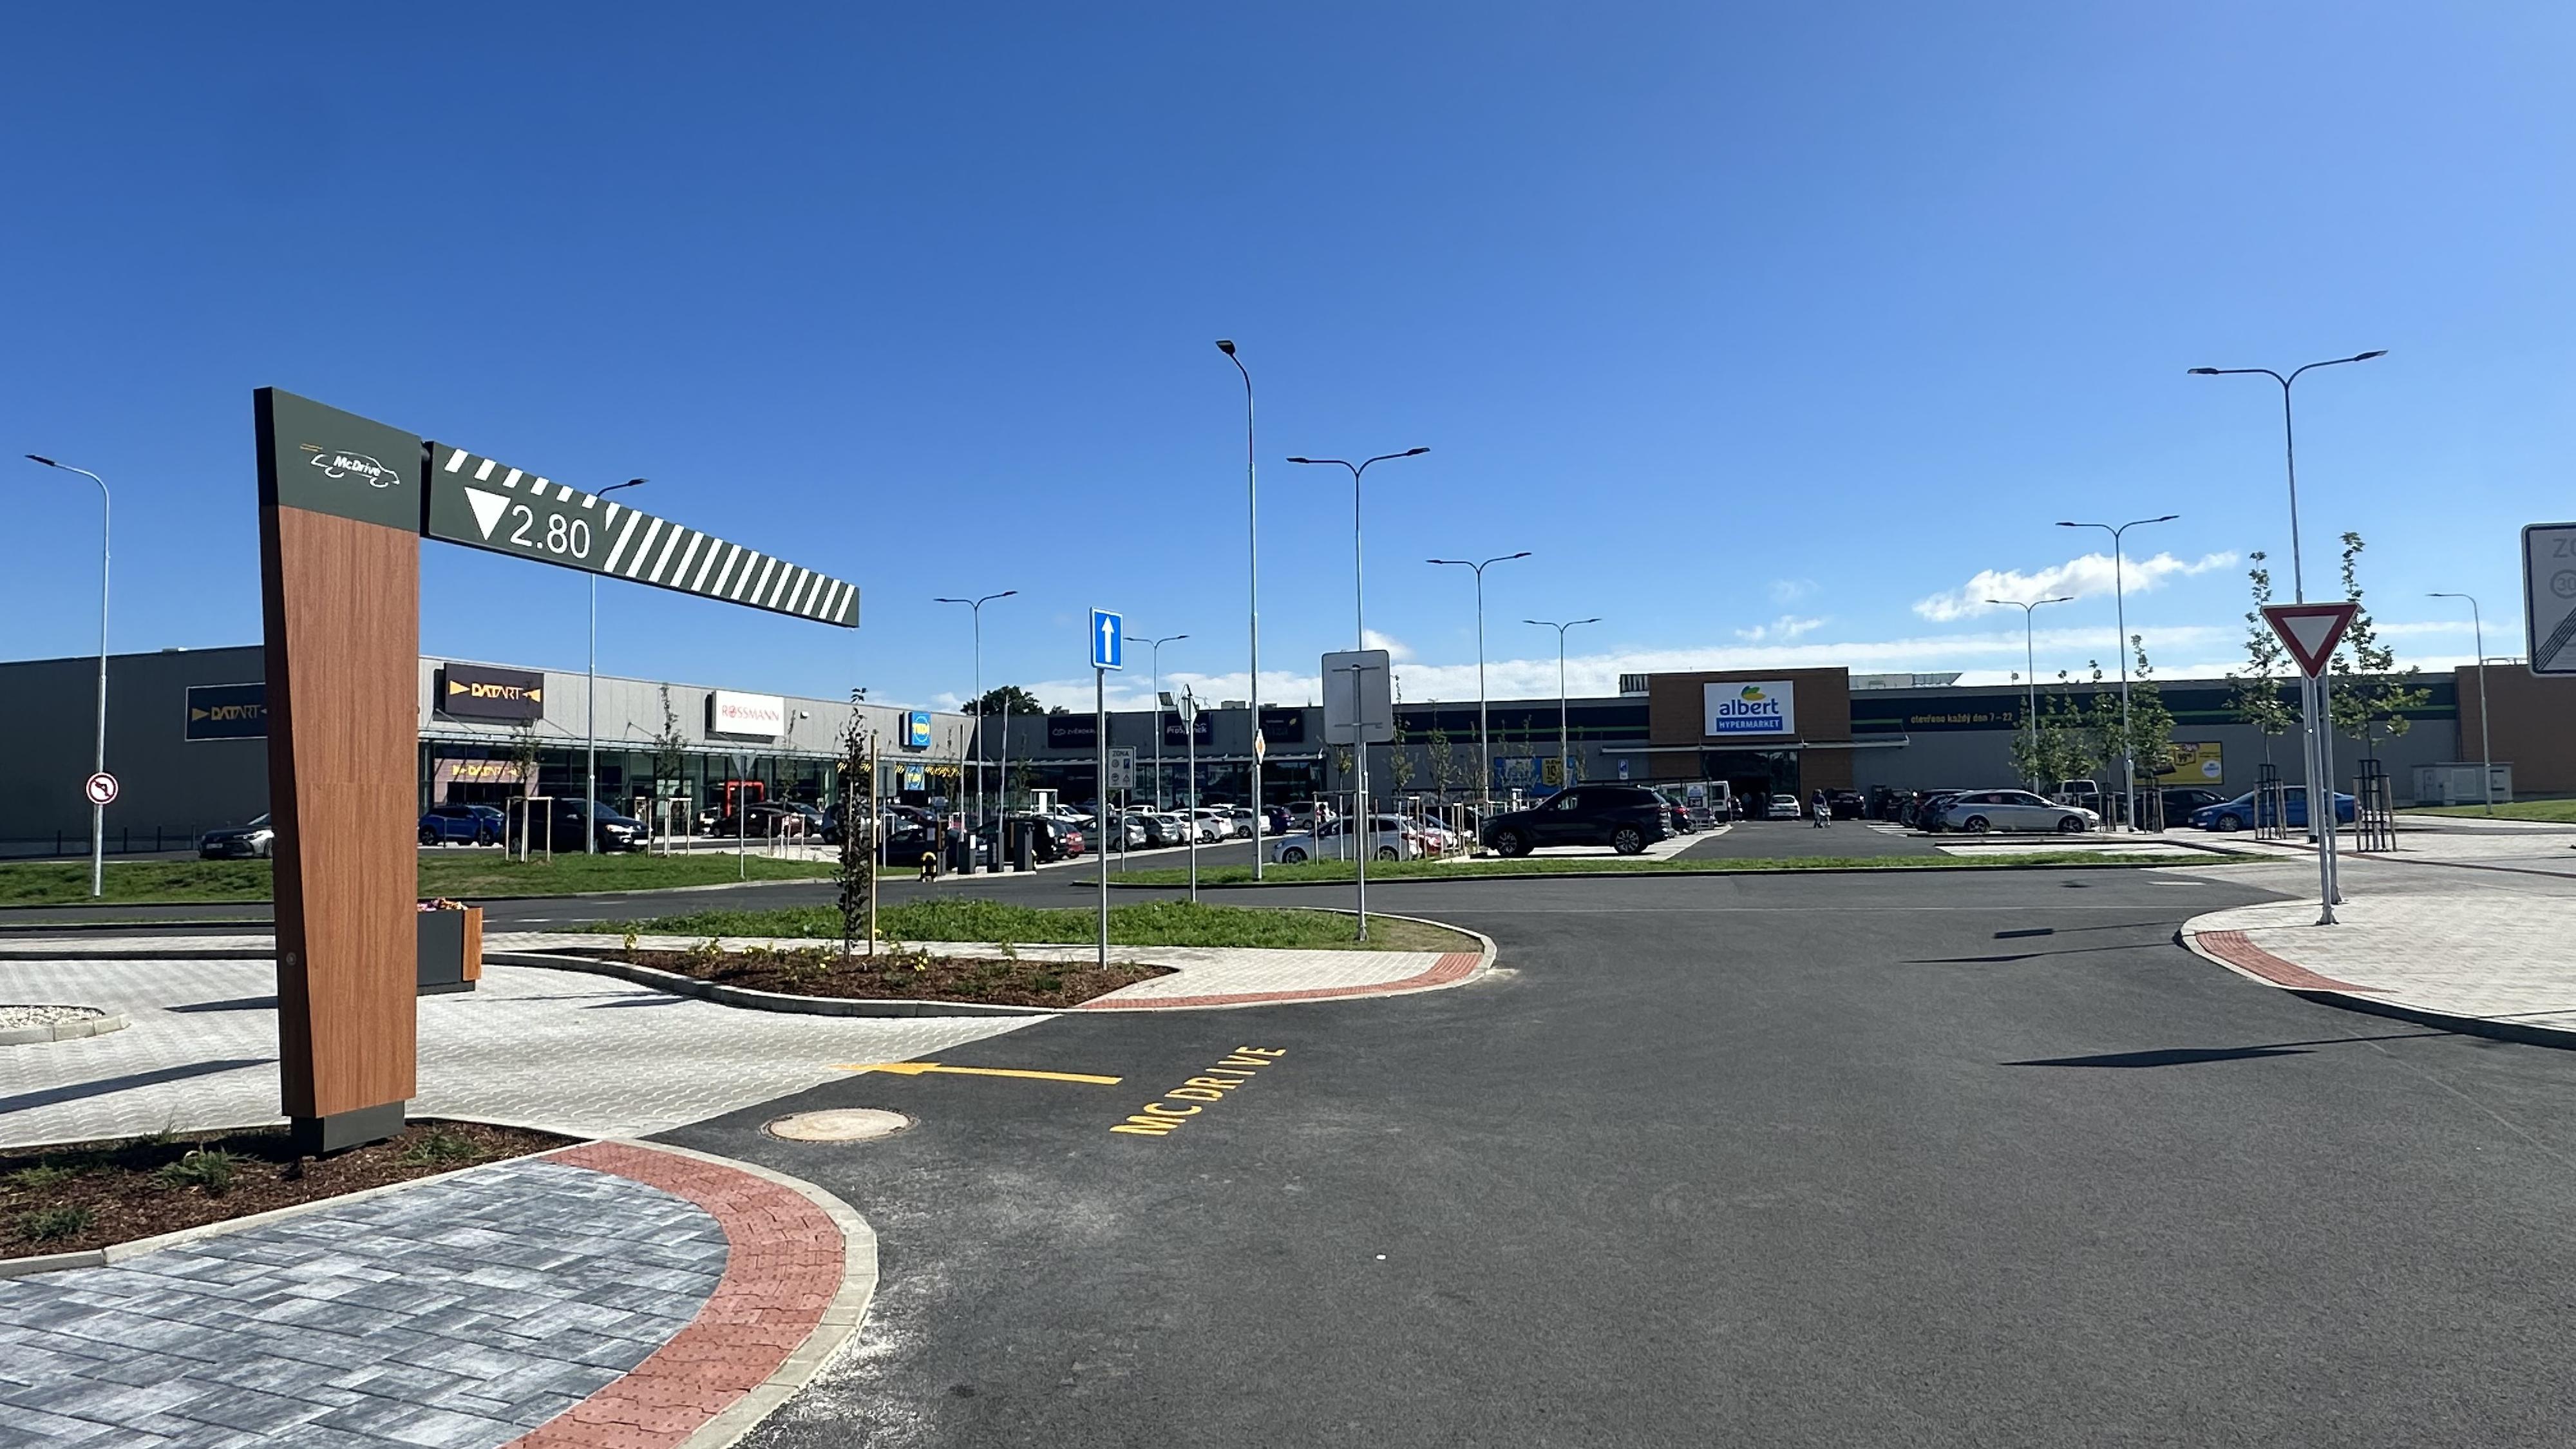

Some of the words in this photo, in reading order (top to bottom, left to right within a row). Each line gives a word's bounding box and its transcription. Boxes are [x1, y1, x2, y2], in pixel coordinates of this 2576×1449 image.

[333, 455, 381, 477] McDrive
[510, 505, 591, 558] 2.80
[471, 683, 524, 700] DATART
[211, 705, 261, 721] DATART
[722, 705, 779, 721] ROSSMANN
[1719, 698, 1779, 715] albert
[1719, 719, 1779, 728] HYPERMARKET
